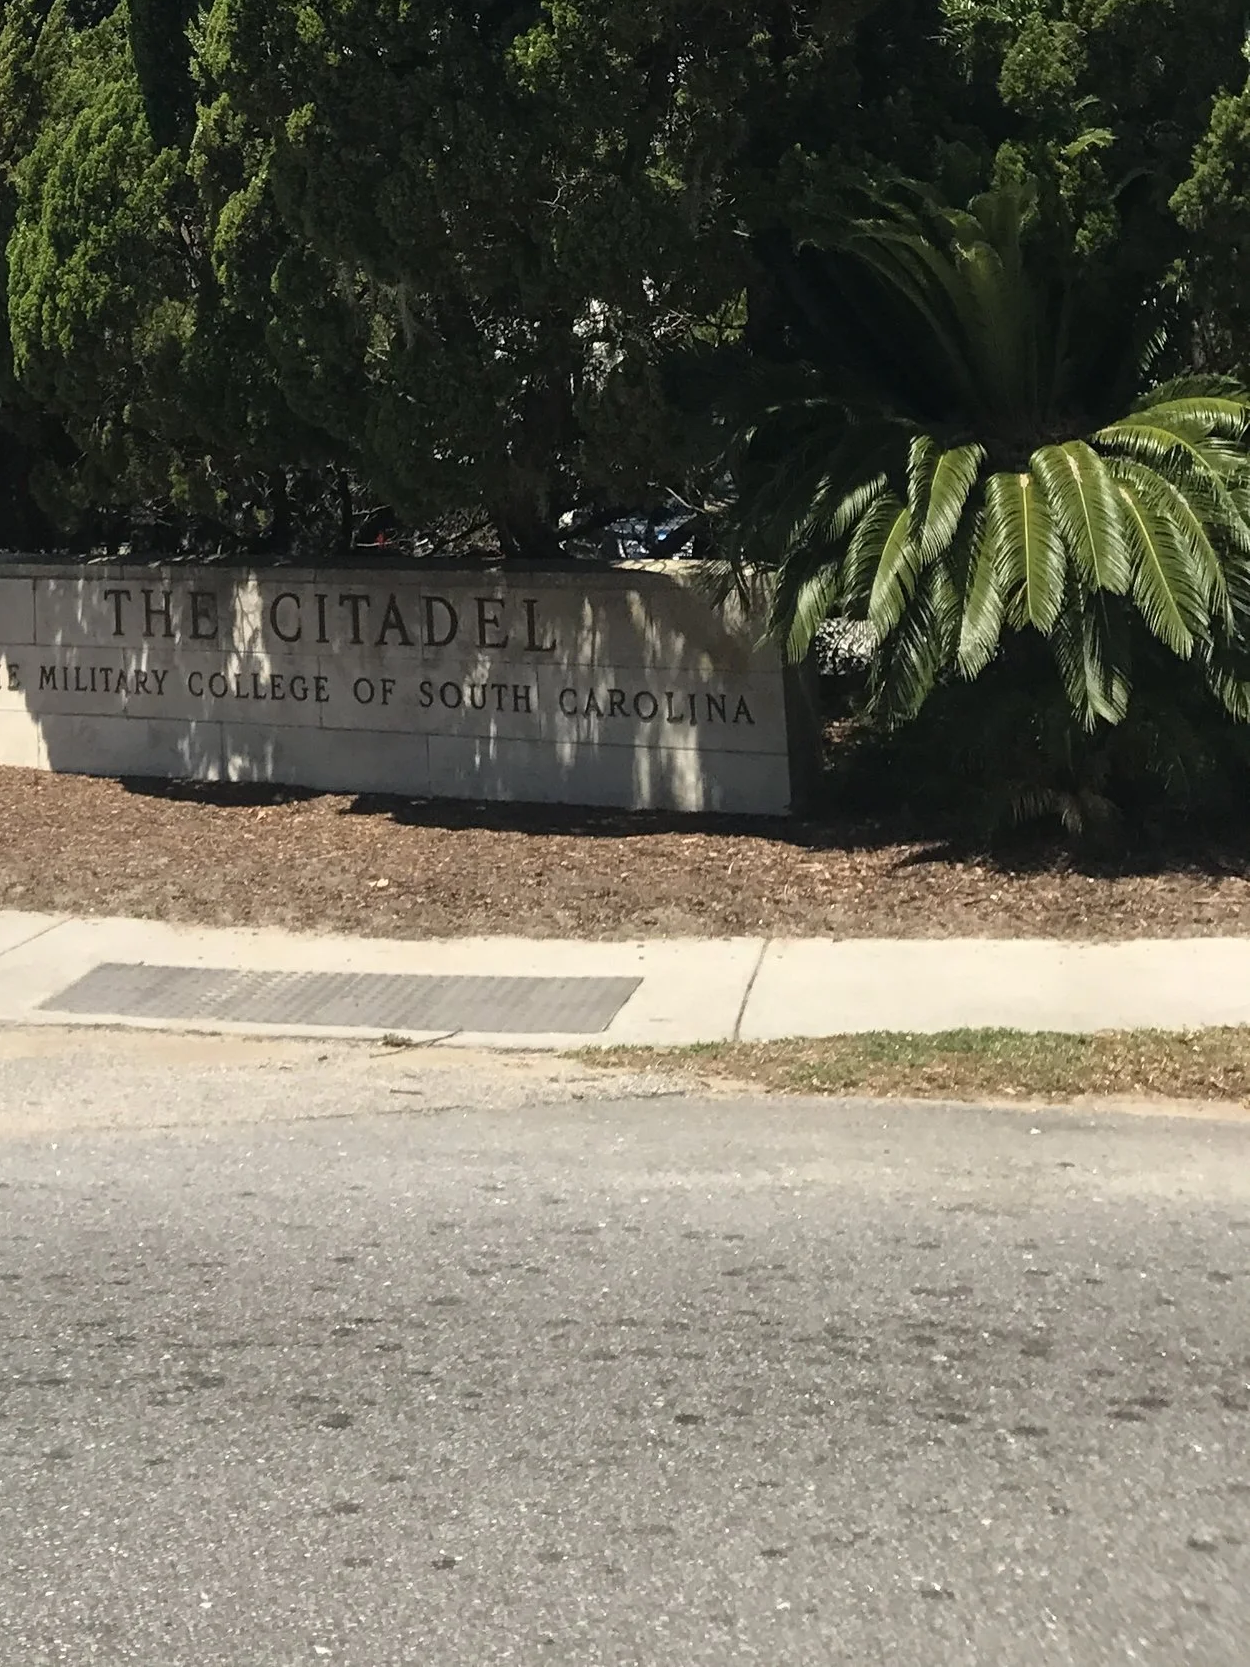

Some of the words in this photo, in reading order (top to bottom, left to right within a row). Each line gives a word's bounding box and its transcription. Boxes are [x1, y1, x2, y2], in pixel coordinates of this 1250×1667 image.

[104, 588, 220, 641] THE
[269, 591, 558, 653] CITADEL
[38, 665, 169, 696] MILITARY
[187, 671, 330, 703] COLLEGE
[353, 677, 397, 706] OF
[418, 680, 532, 714] SOUTH
[558, 687, 756, 726] CAROLINA
